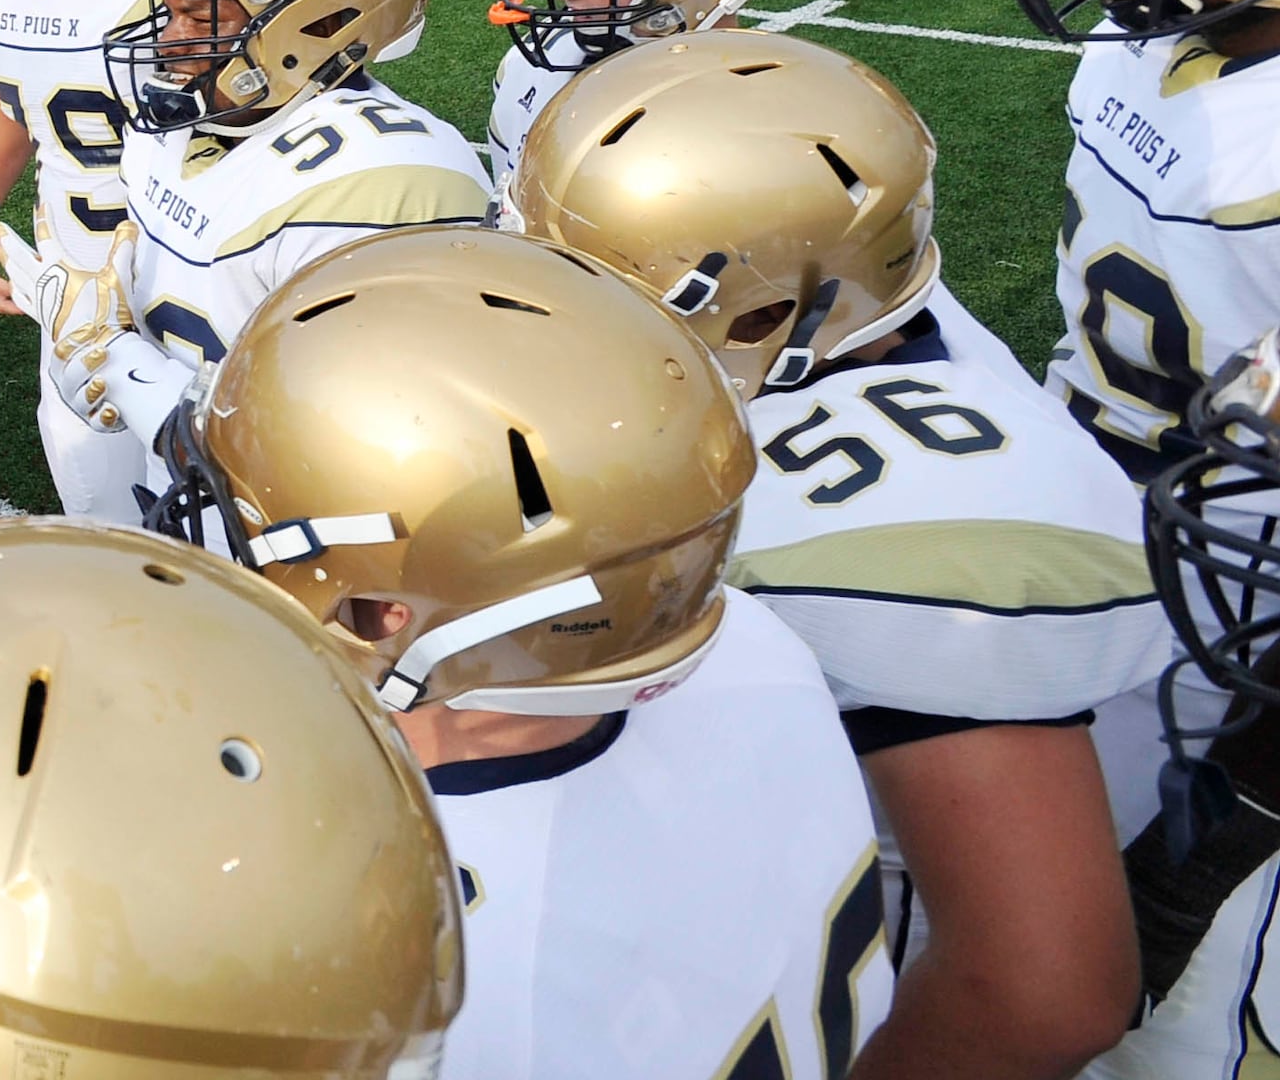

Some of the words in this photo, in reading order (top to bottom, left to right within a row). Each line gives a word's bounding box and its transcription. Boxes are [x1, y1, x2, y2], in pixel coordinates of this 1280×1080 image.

[0, 12, 19, 33] ST.
[23, 15, 62, 36] PIUS
[67, 19, 80, 37] X
[1095, 96, 1126, 132] ST.
[1118, 111, 1166, 165] PIUS
[1155, 147, 1182, 181] X
[160, 188, 199, 233] PIUS
[195, 214, 211, 241] X
[757, 375, 1013, 509] 56
[550, 618, 613, 633] Riddell
